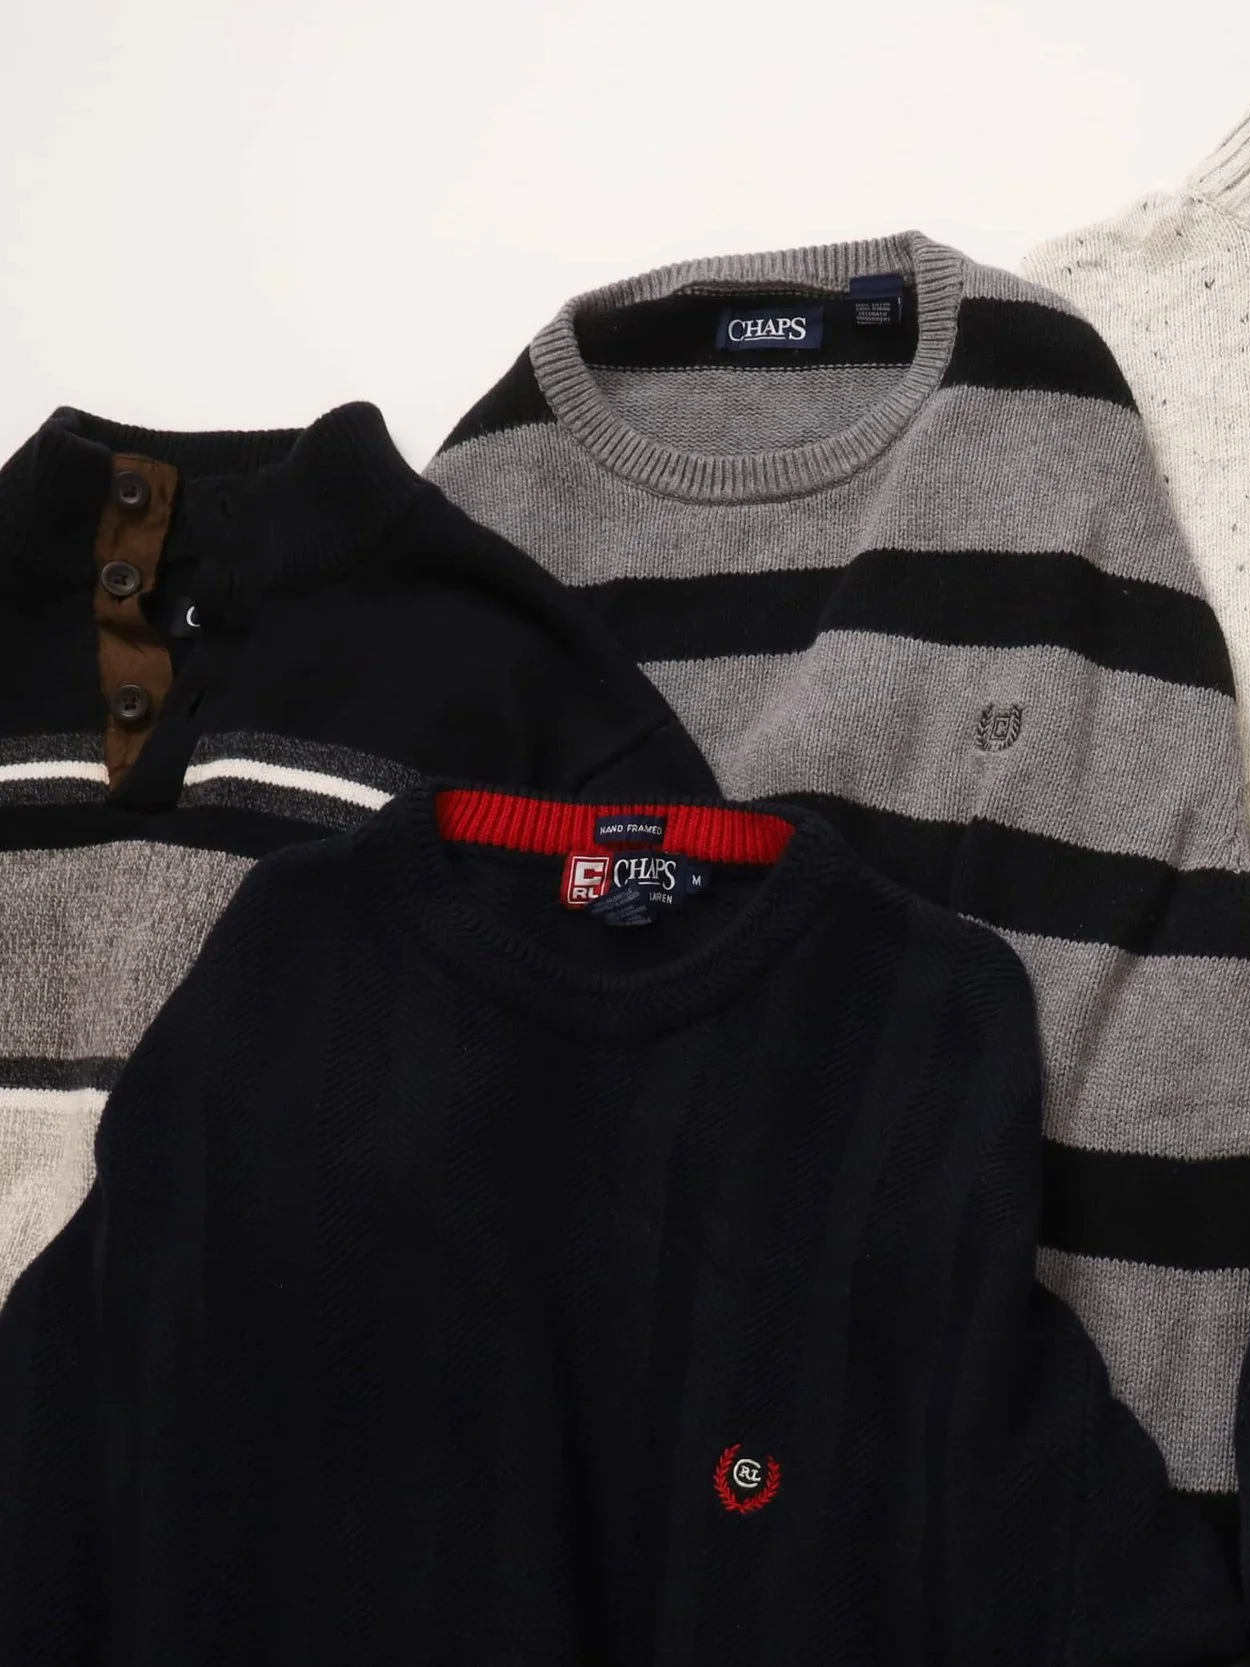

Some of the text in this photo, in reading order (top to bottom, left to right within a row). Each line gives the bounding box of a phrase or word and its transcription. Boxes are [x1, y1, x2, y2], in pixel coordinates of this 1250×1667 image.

[728, 317, 807, 342] CHAPS
[600, 824, 663, 836] HAND FRAMED
[613, 858, 677, 890] CHAPS
[692, 875, 702, 886] M
[572, 887, 599, 899] RL
